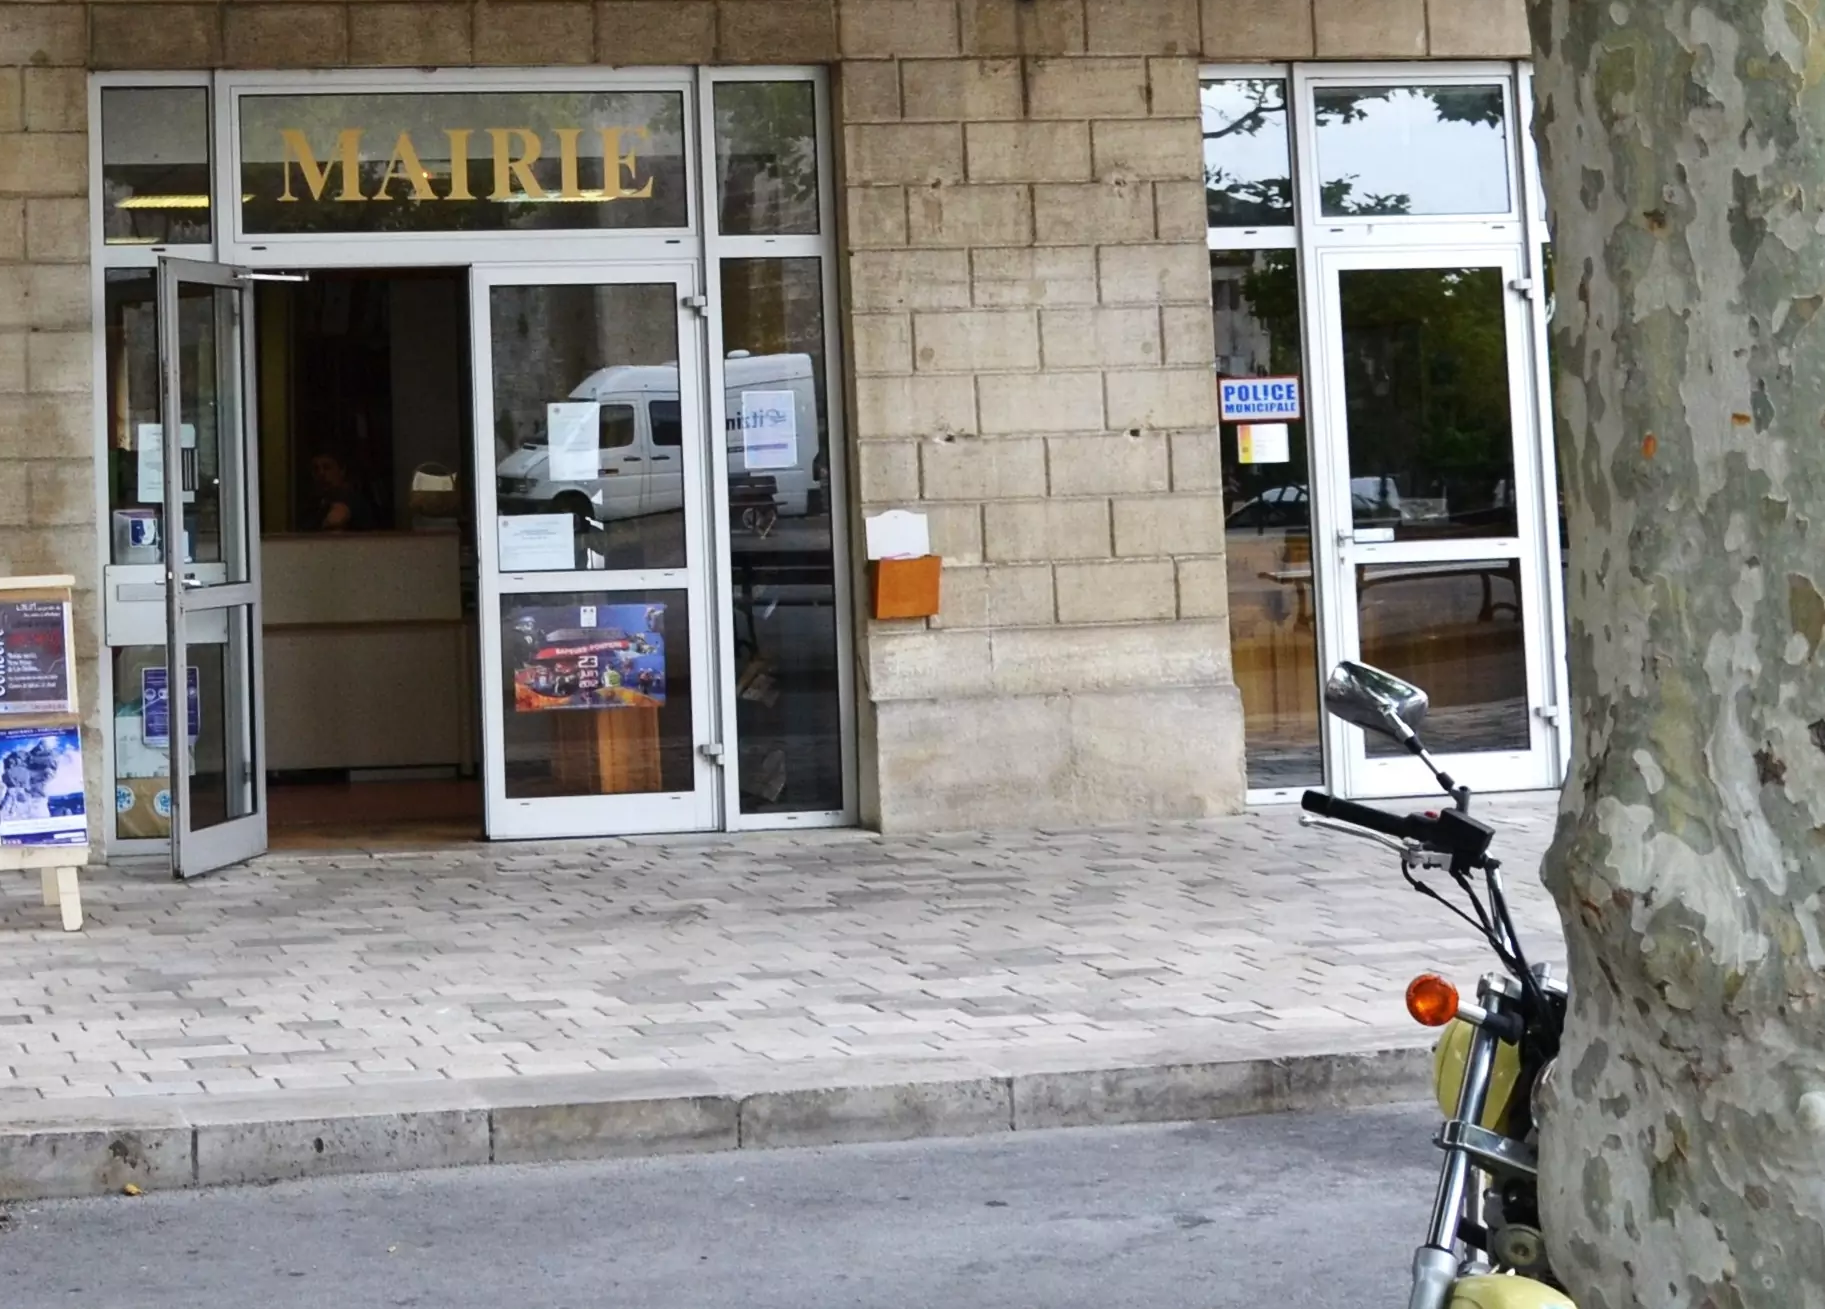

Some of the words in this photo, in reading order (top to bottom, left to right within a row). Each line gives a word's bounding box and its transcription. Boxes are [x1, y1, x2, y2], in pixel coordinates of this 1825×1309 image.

[277, 128, 654, 201] MAIRIE
[1223, 384, 1296, 402] POLICE
[1225, 403, 1296, 413] MUNICIPALE
[578, 655, 598, 668] 23
